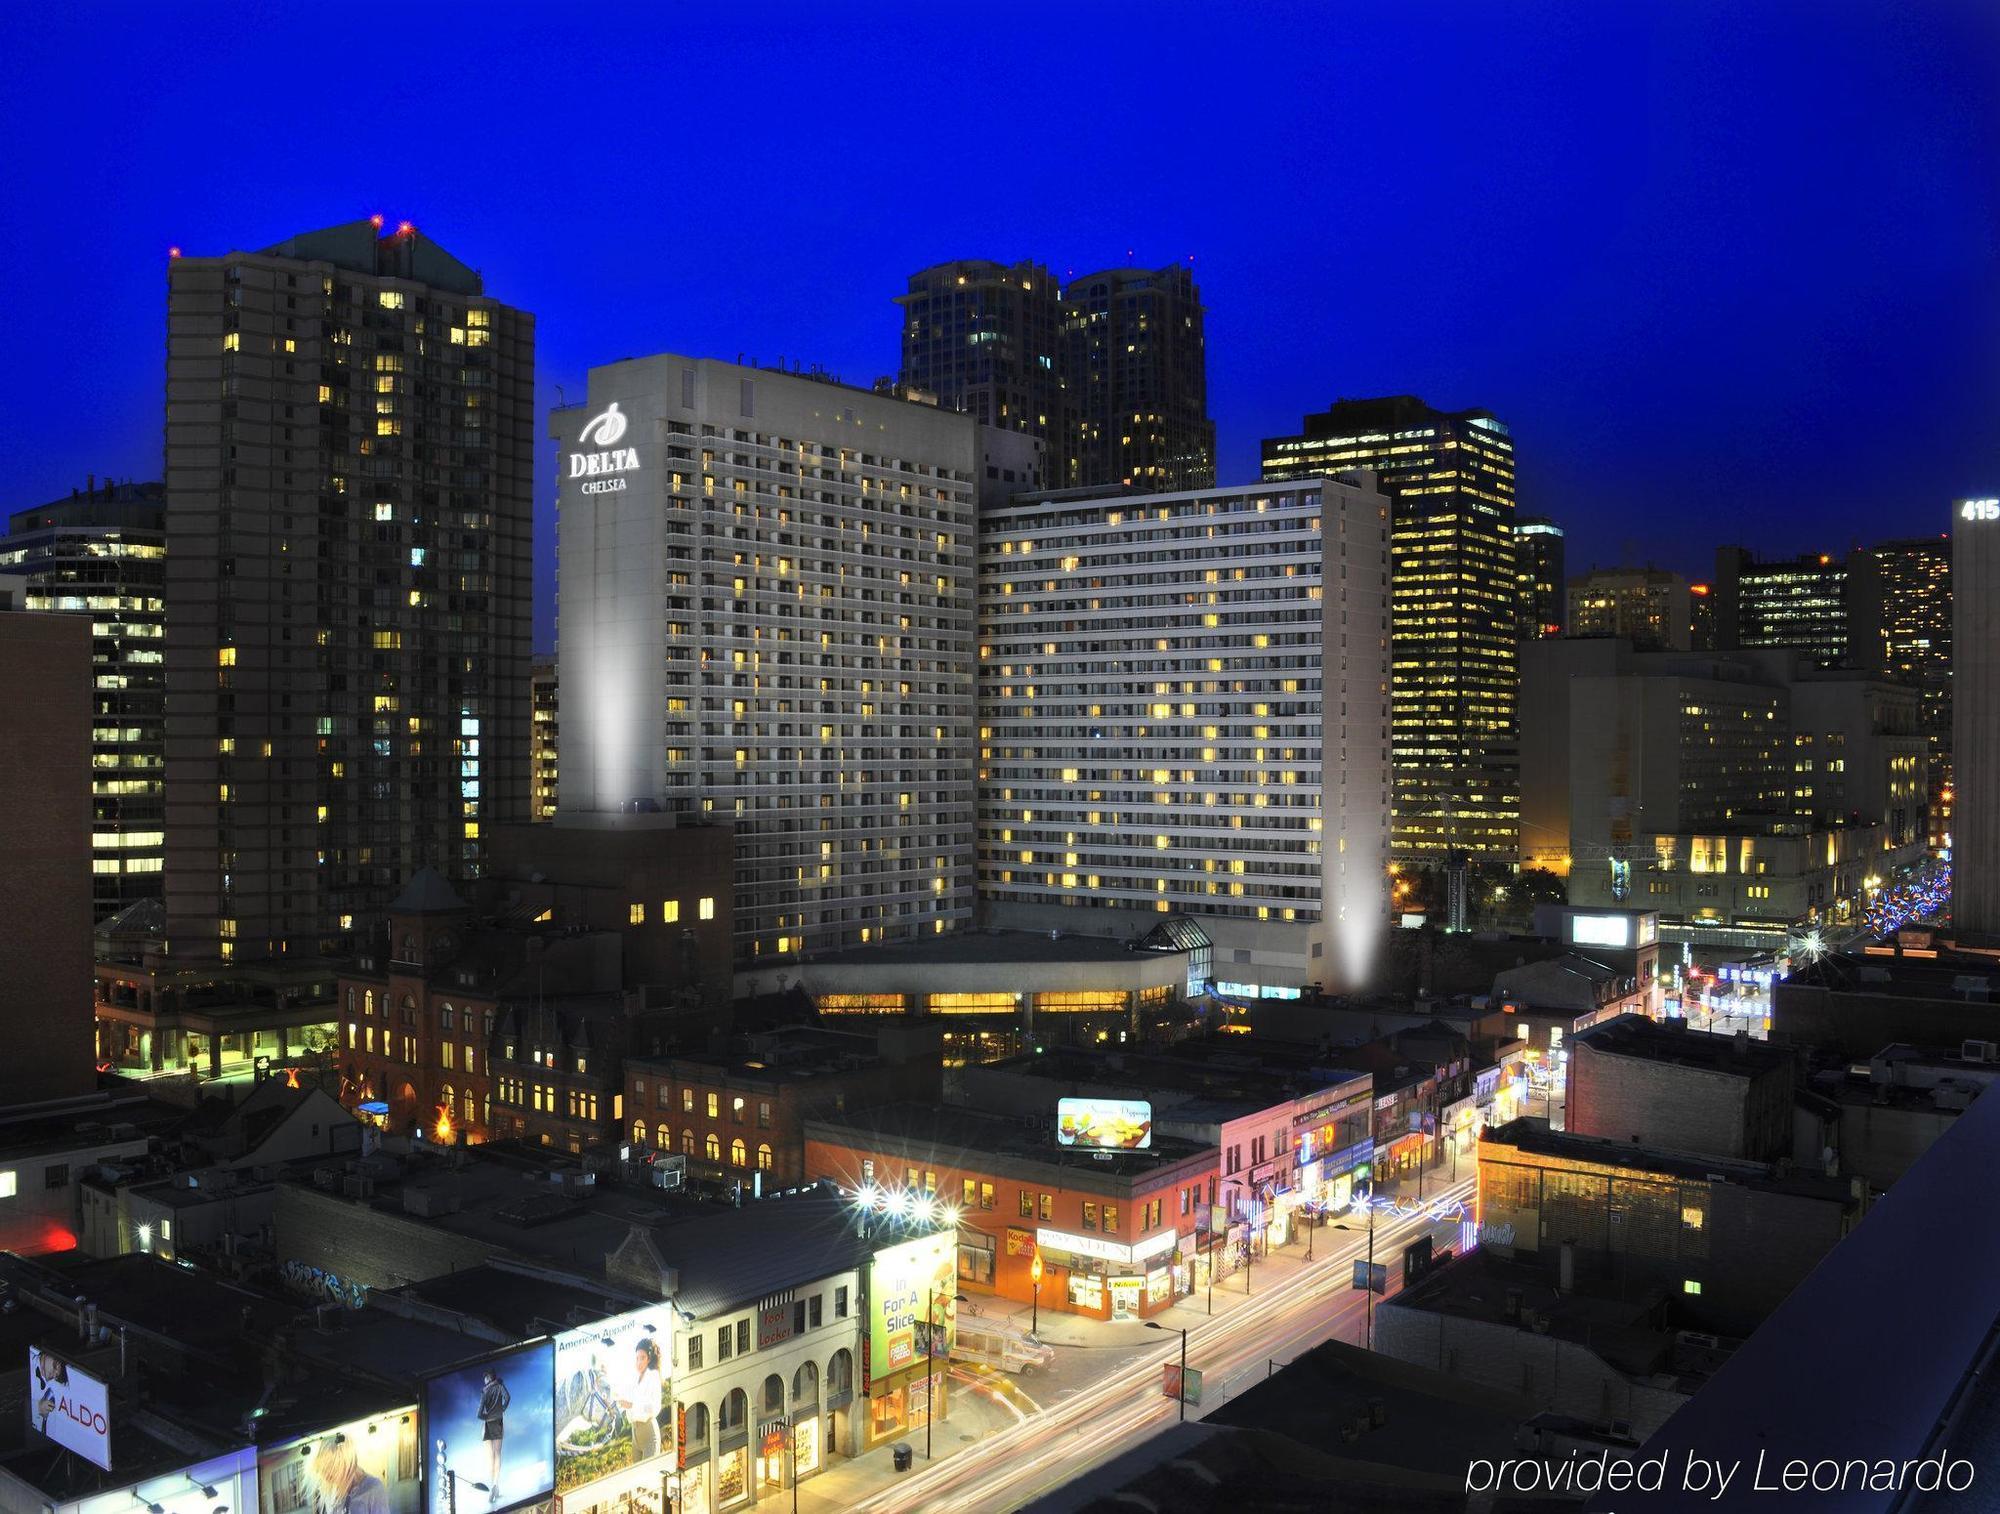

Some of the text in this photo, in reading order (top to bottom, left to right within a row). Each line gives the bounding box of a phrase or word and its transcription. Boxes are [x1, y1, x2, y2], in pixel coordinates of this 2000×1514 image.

[569, 447, 641, 478] DELTA
[581, 478, 627, 495] CHELSEA
[1961, 499, 2000, 520] 415
[884, 1291, 918, 1315] For A
[764, 1309, 785, 1326] Foot
[887, 1313, 915, 1333] Slice
[760, 1328, 792, 1346] Locker
[58, 1395, 107, 1435] ALDO
